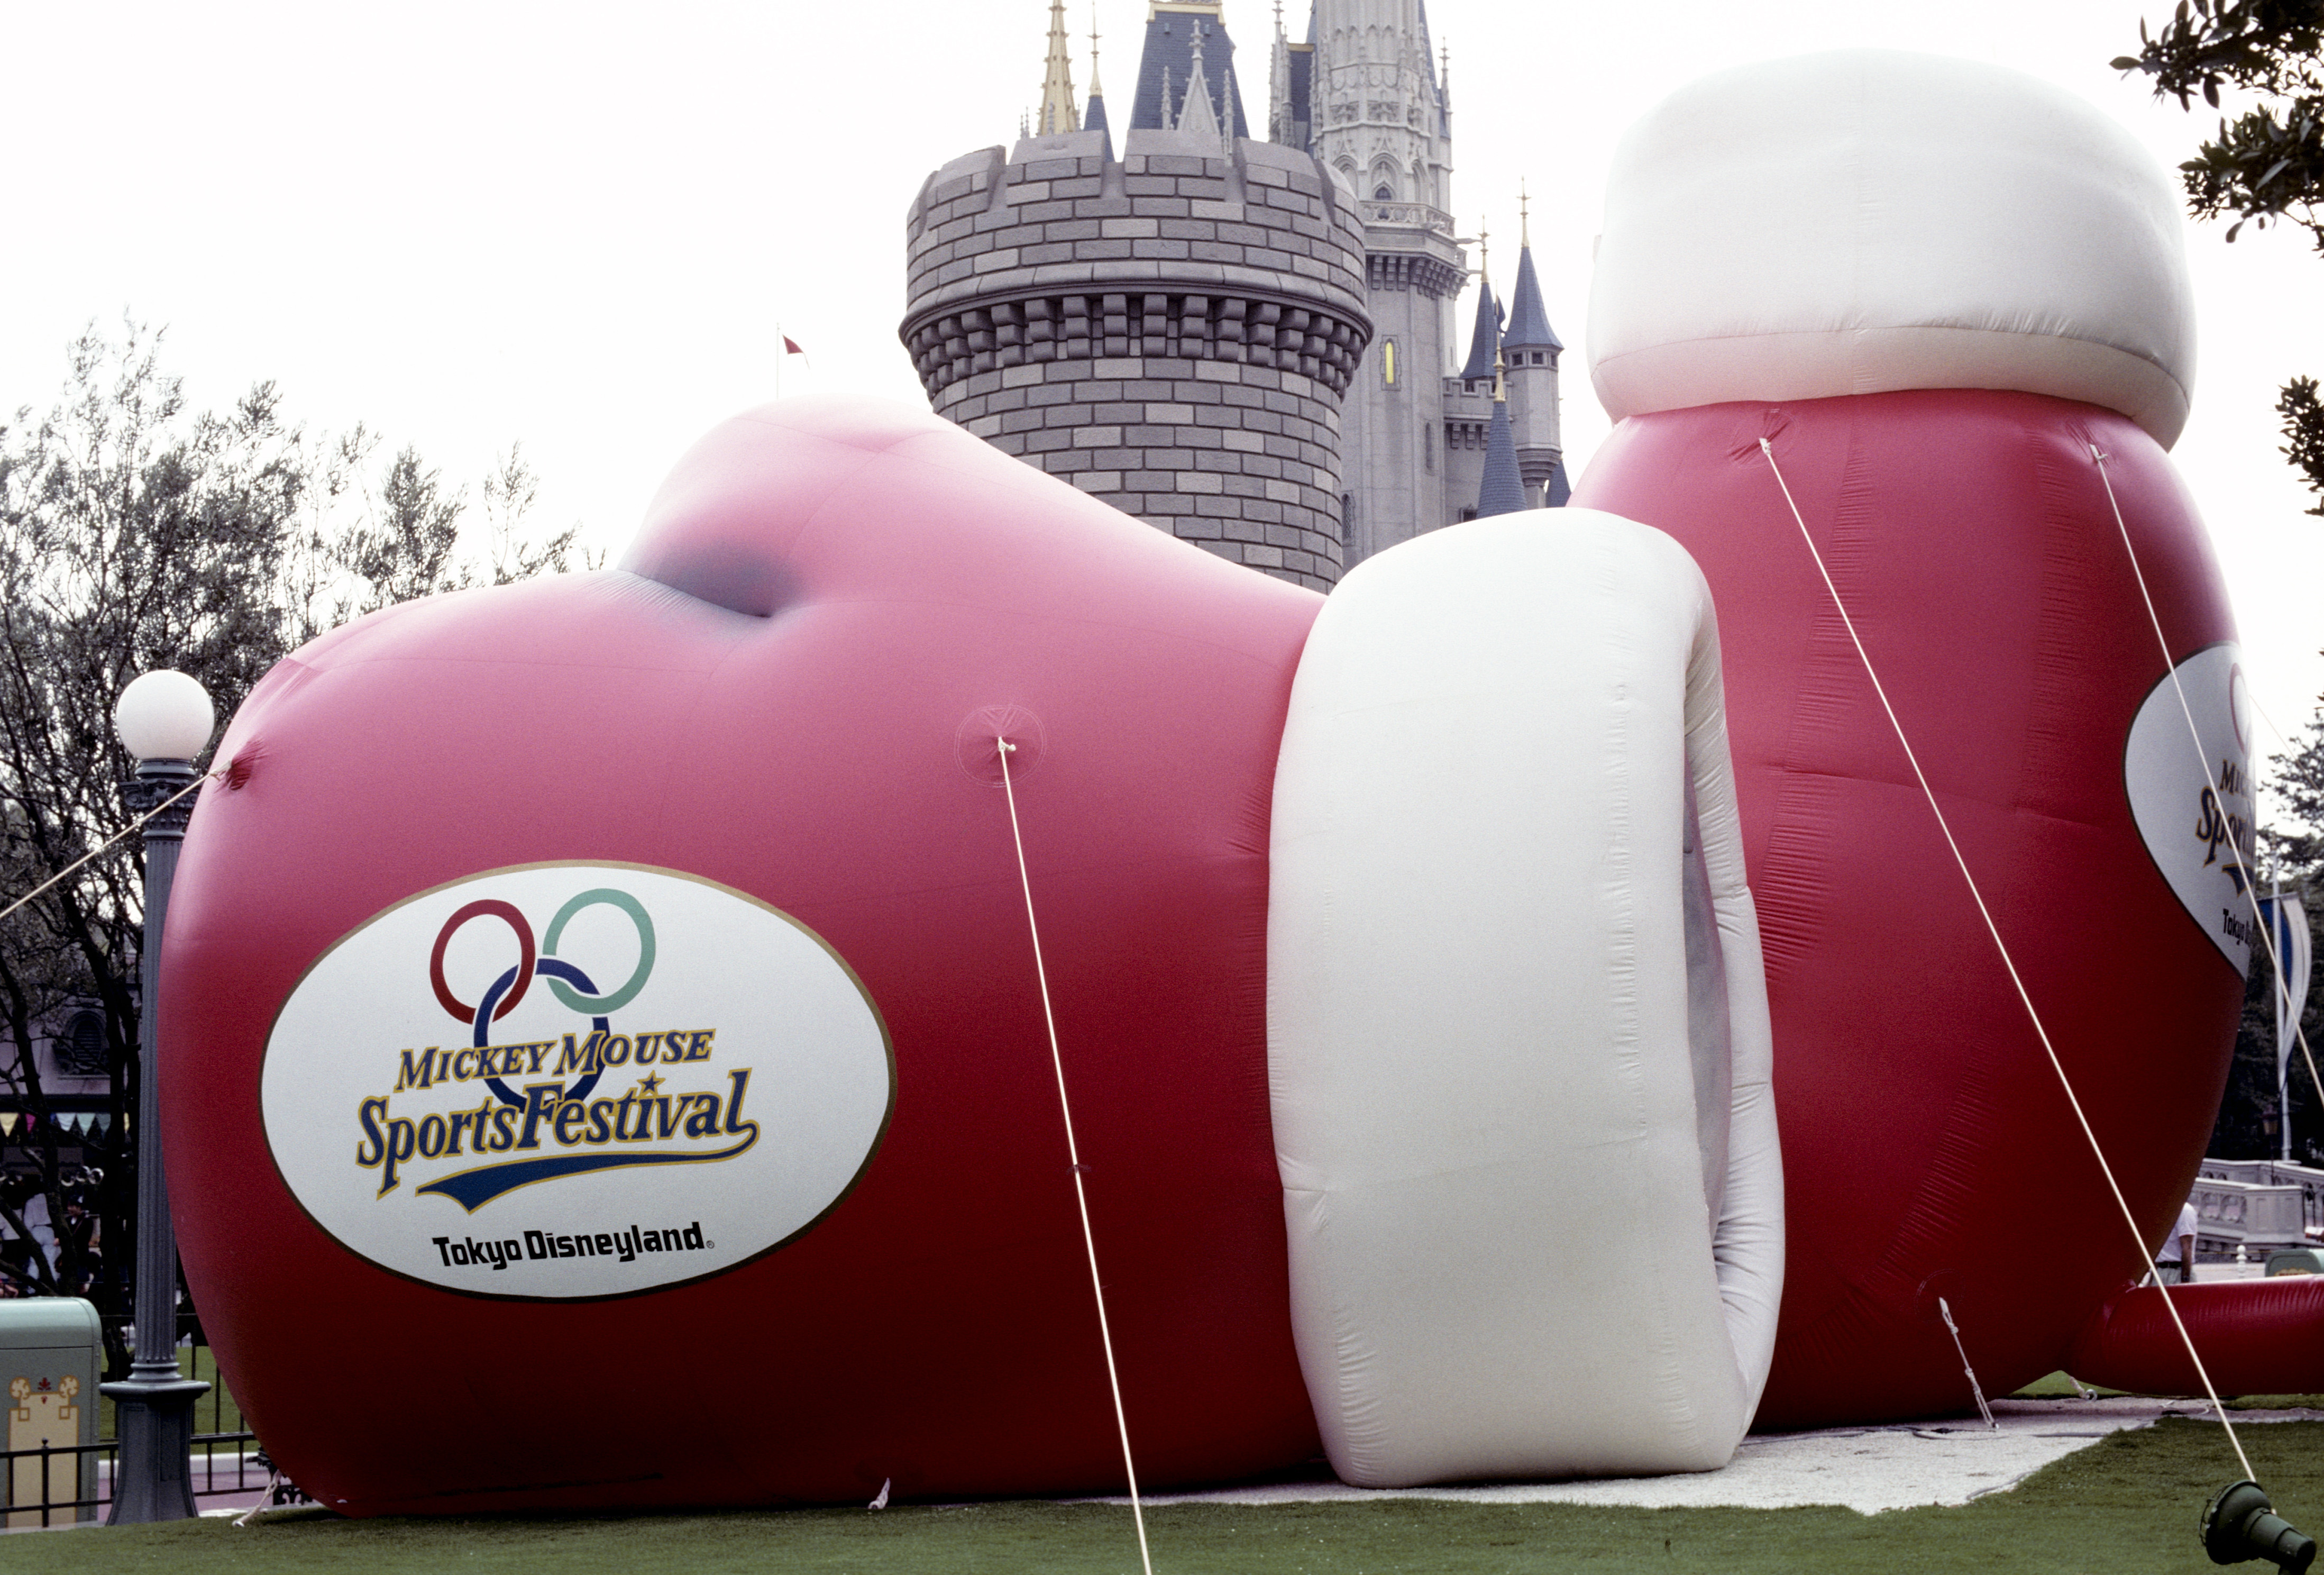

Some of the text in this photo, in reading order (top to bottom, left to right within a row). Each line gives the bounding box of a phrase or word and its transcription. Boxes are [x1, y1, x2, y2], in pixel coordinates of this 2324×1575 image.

[2223, 908, 2245, 946] Tokyo
[393, 1028, 716, 1093] MICKEY MOUSE
[356, 1067, 760, 1201] Sports Festival
[432, 1236, 522, 1271] Tokyo
